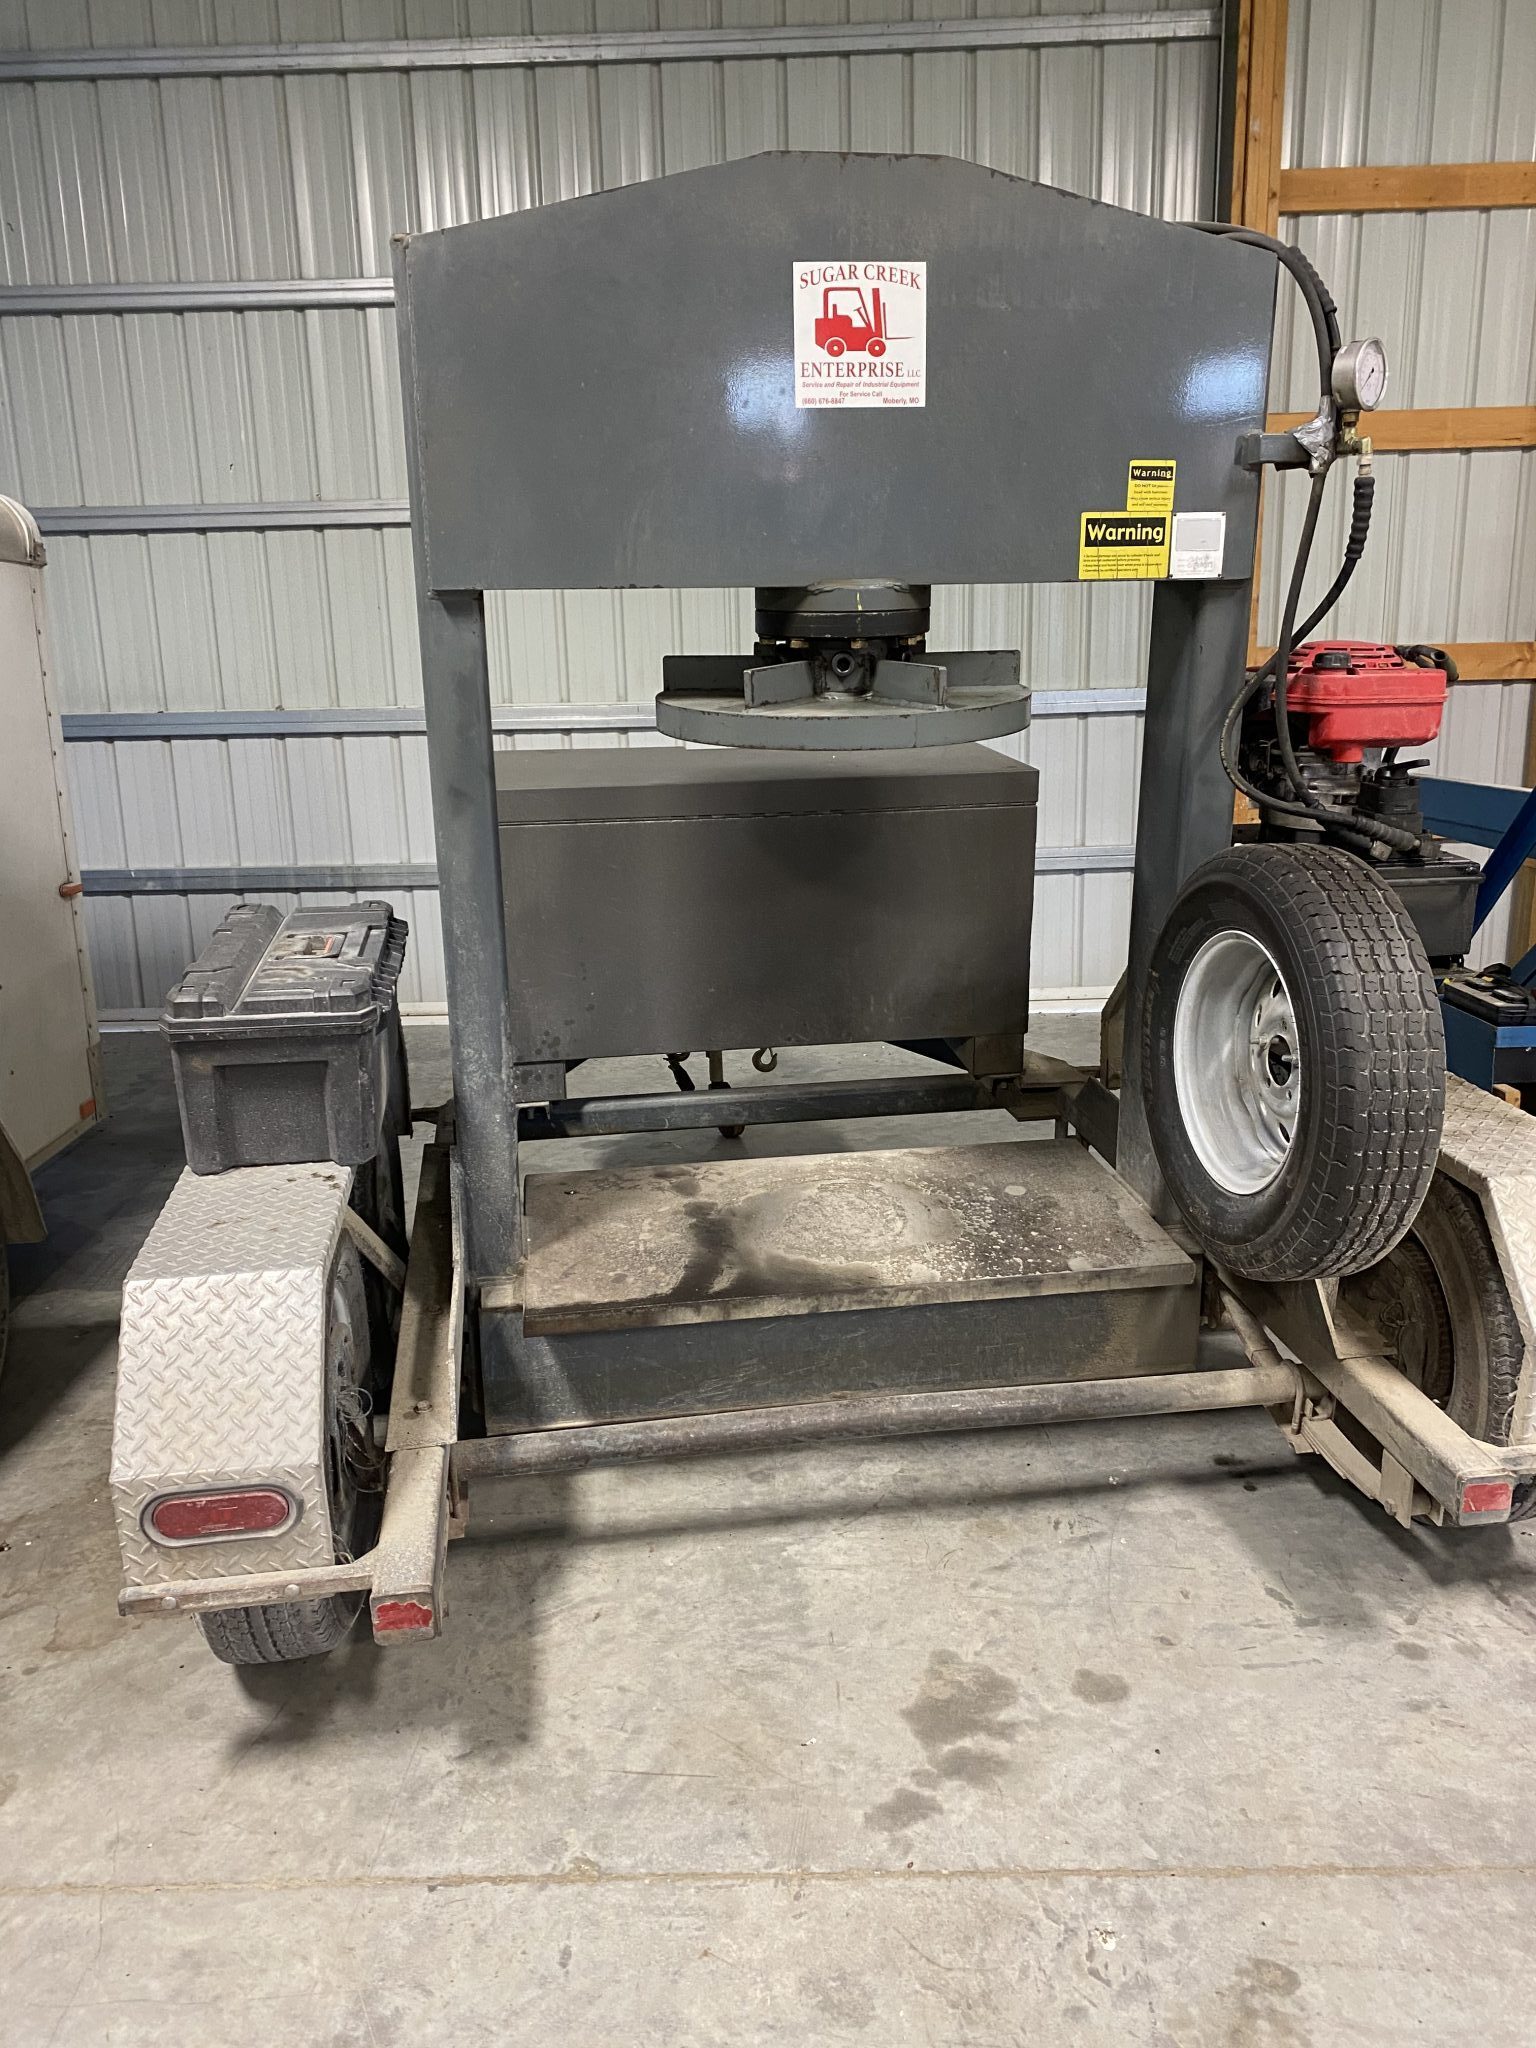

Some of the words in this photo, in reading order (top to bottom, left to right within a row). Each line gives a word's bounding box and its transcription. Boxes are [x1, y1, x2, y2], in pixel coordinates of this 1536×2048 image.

[800, 264, 859, 289] SUGAR
[864, 264, 921, 290] CREEK
[801, 361, 904, 378] ENTERPRISE
[907, 369, 921, 378] LLC
[836, 381, 853, 389] Repair
[890, 381, 920, 389] Equipment
[883, 397, 908, 405] Moberly,
[1133, 469, 1173, 479] Warning
[1087, 523, 1164, 543] Warning
